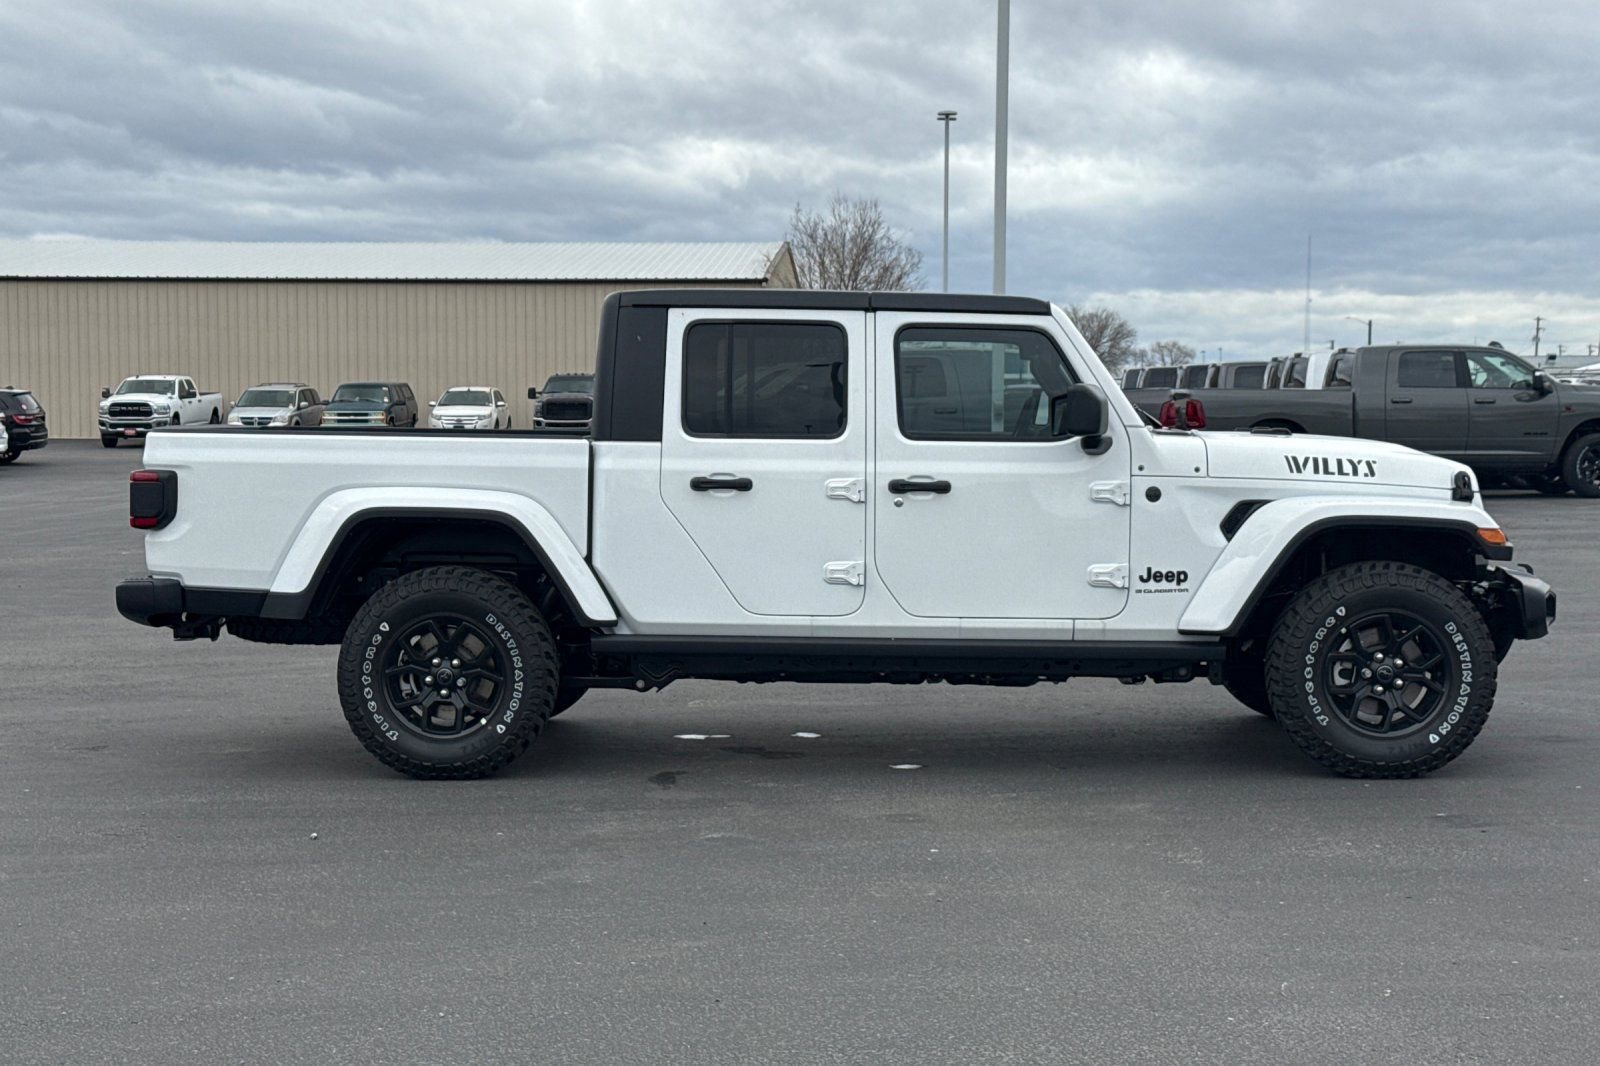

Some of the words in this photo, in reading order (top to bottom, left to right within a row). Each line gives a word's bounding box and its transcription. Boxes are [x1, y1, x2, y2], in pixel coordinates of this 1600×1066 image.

[1284, 455, 1377, 477] WILLYS
[1138, 566, 1189, 586] Jeep
[361, 633, 399, 741] Firestone
[485, 613, 523, 723] DESTINATION
[1304, 616, 1336, 726] Firestone
[1438, 621, 1473, 736] DESTINATION
